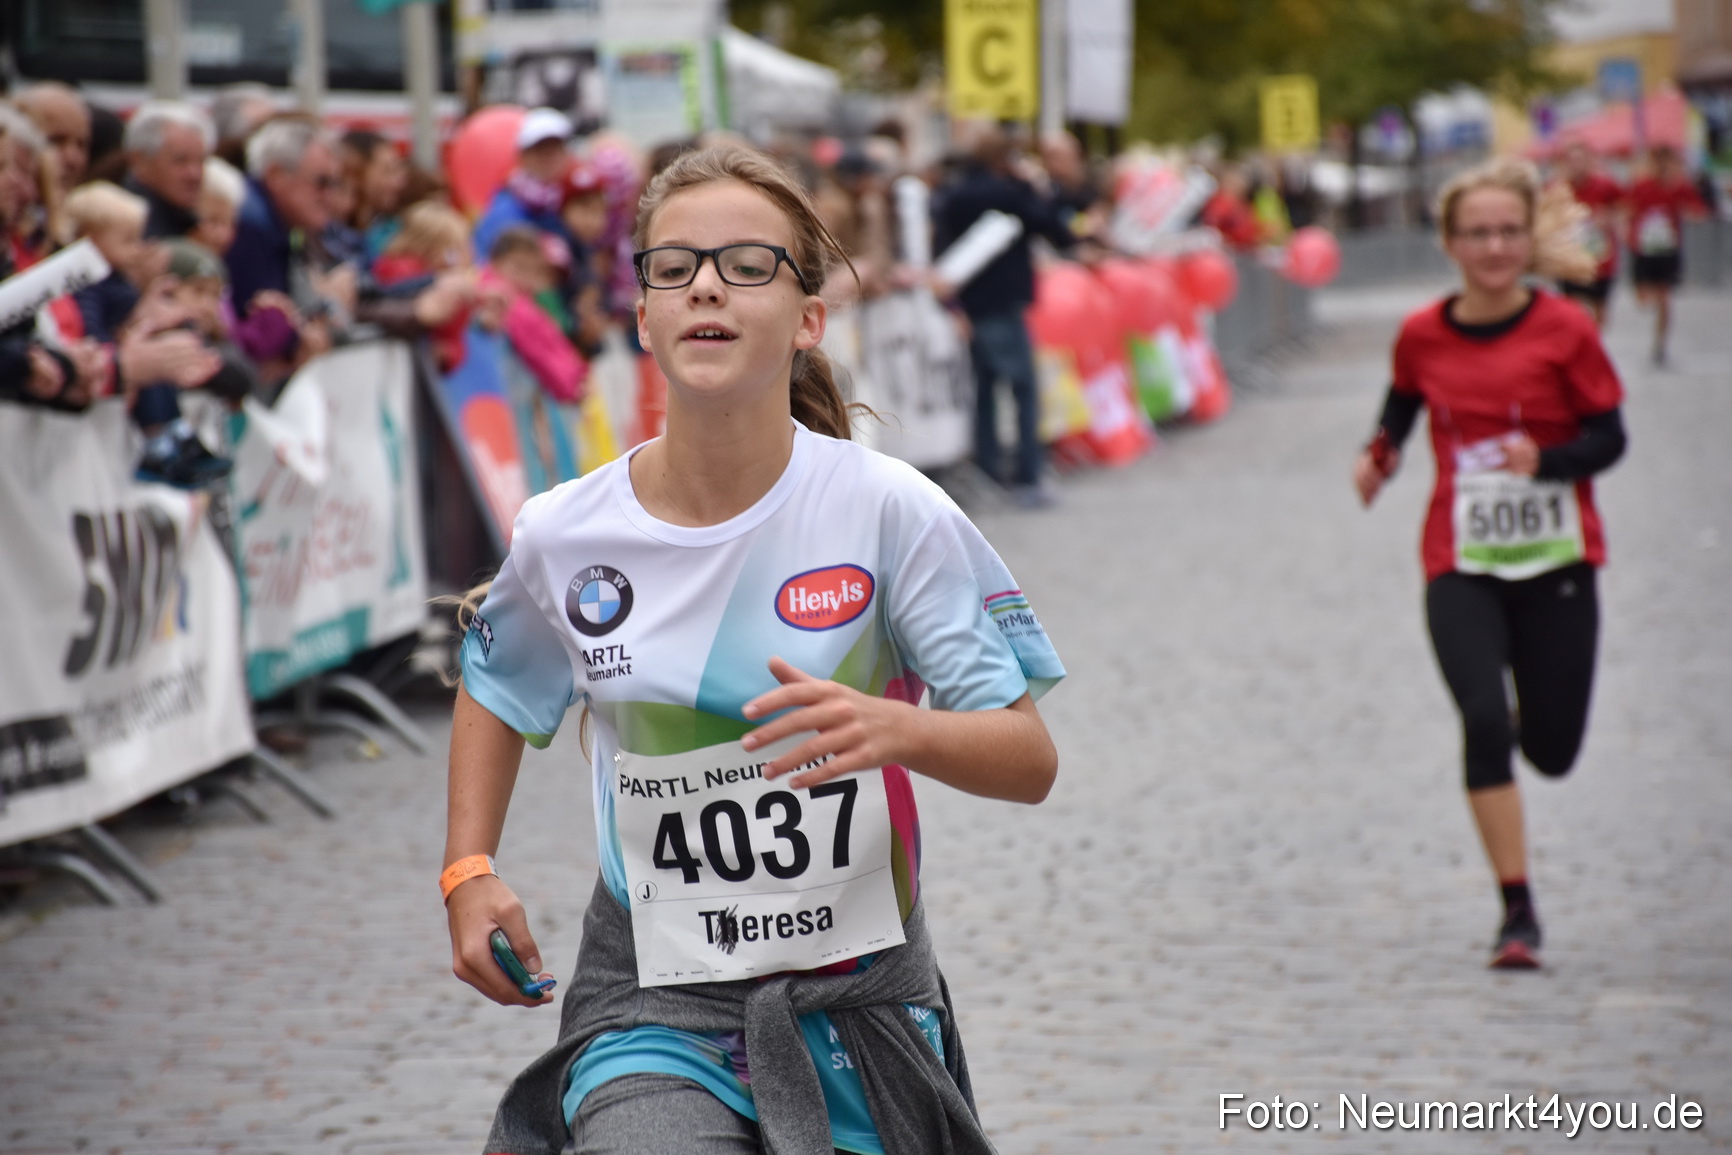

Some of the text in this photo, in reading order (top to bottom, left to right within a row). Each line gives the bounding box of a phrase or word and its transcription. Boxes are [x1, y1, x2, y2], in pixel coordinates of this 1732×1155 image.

[970, 25, 1016, 88] C
[1468, 495, 1563, 541] 5061
[570, 567, 628, 592] BMW
[788, 579, 864, 613] Hervis
[795, 609, 832, 620] SPORTS
[582, 644, 632, 667] ARTL
[586, 662, 632, 682] eumarkt
[619, 773, 699, 799] PARTL
[653, 778, 858, 884] 4037
[642, 884, 651, 900] J
